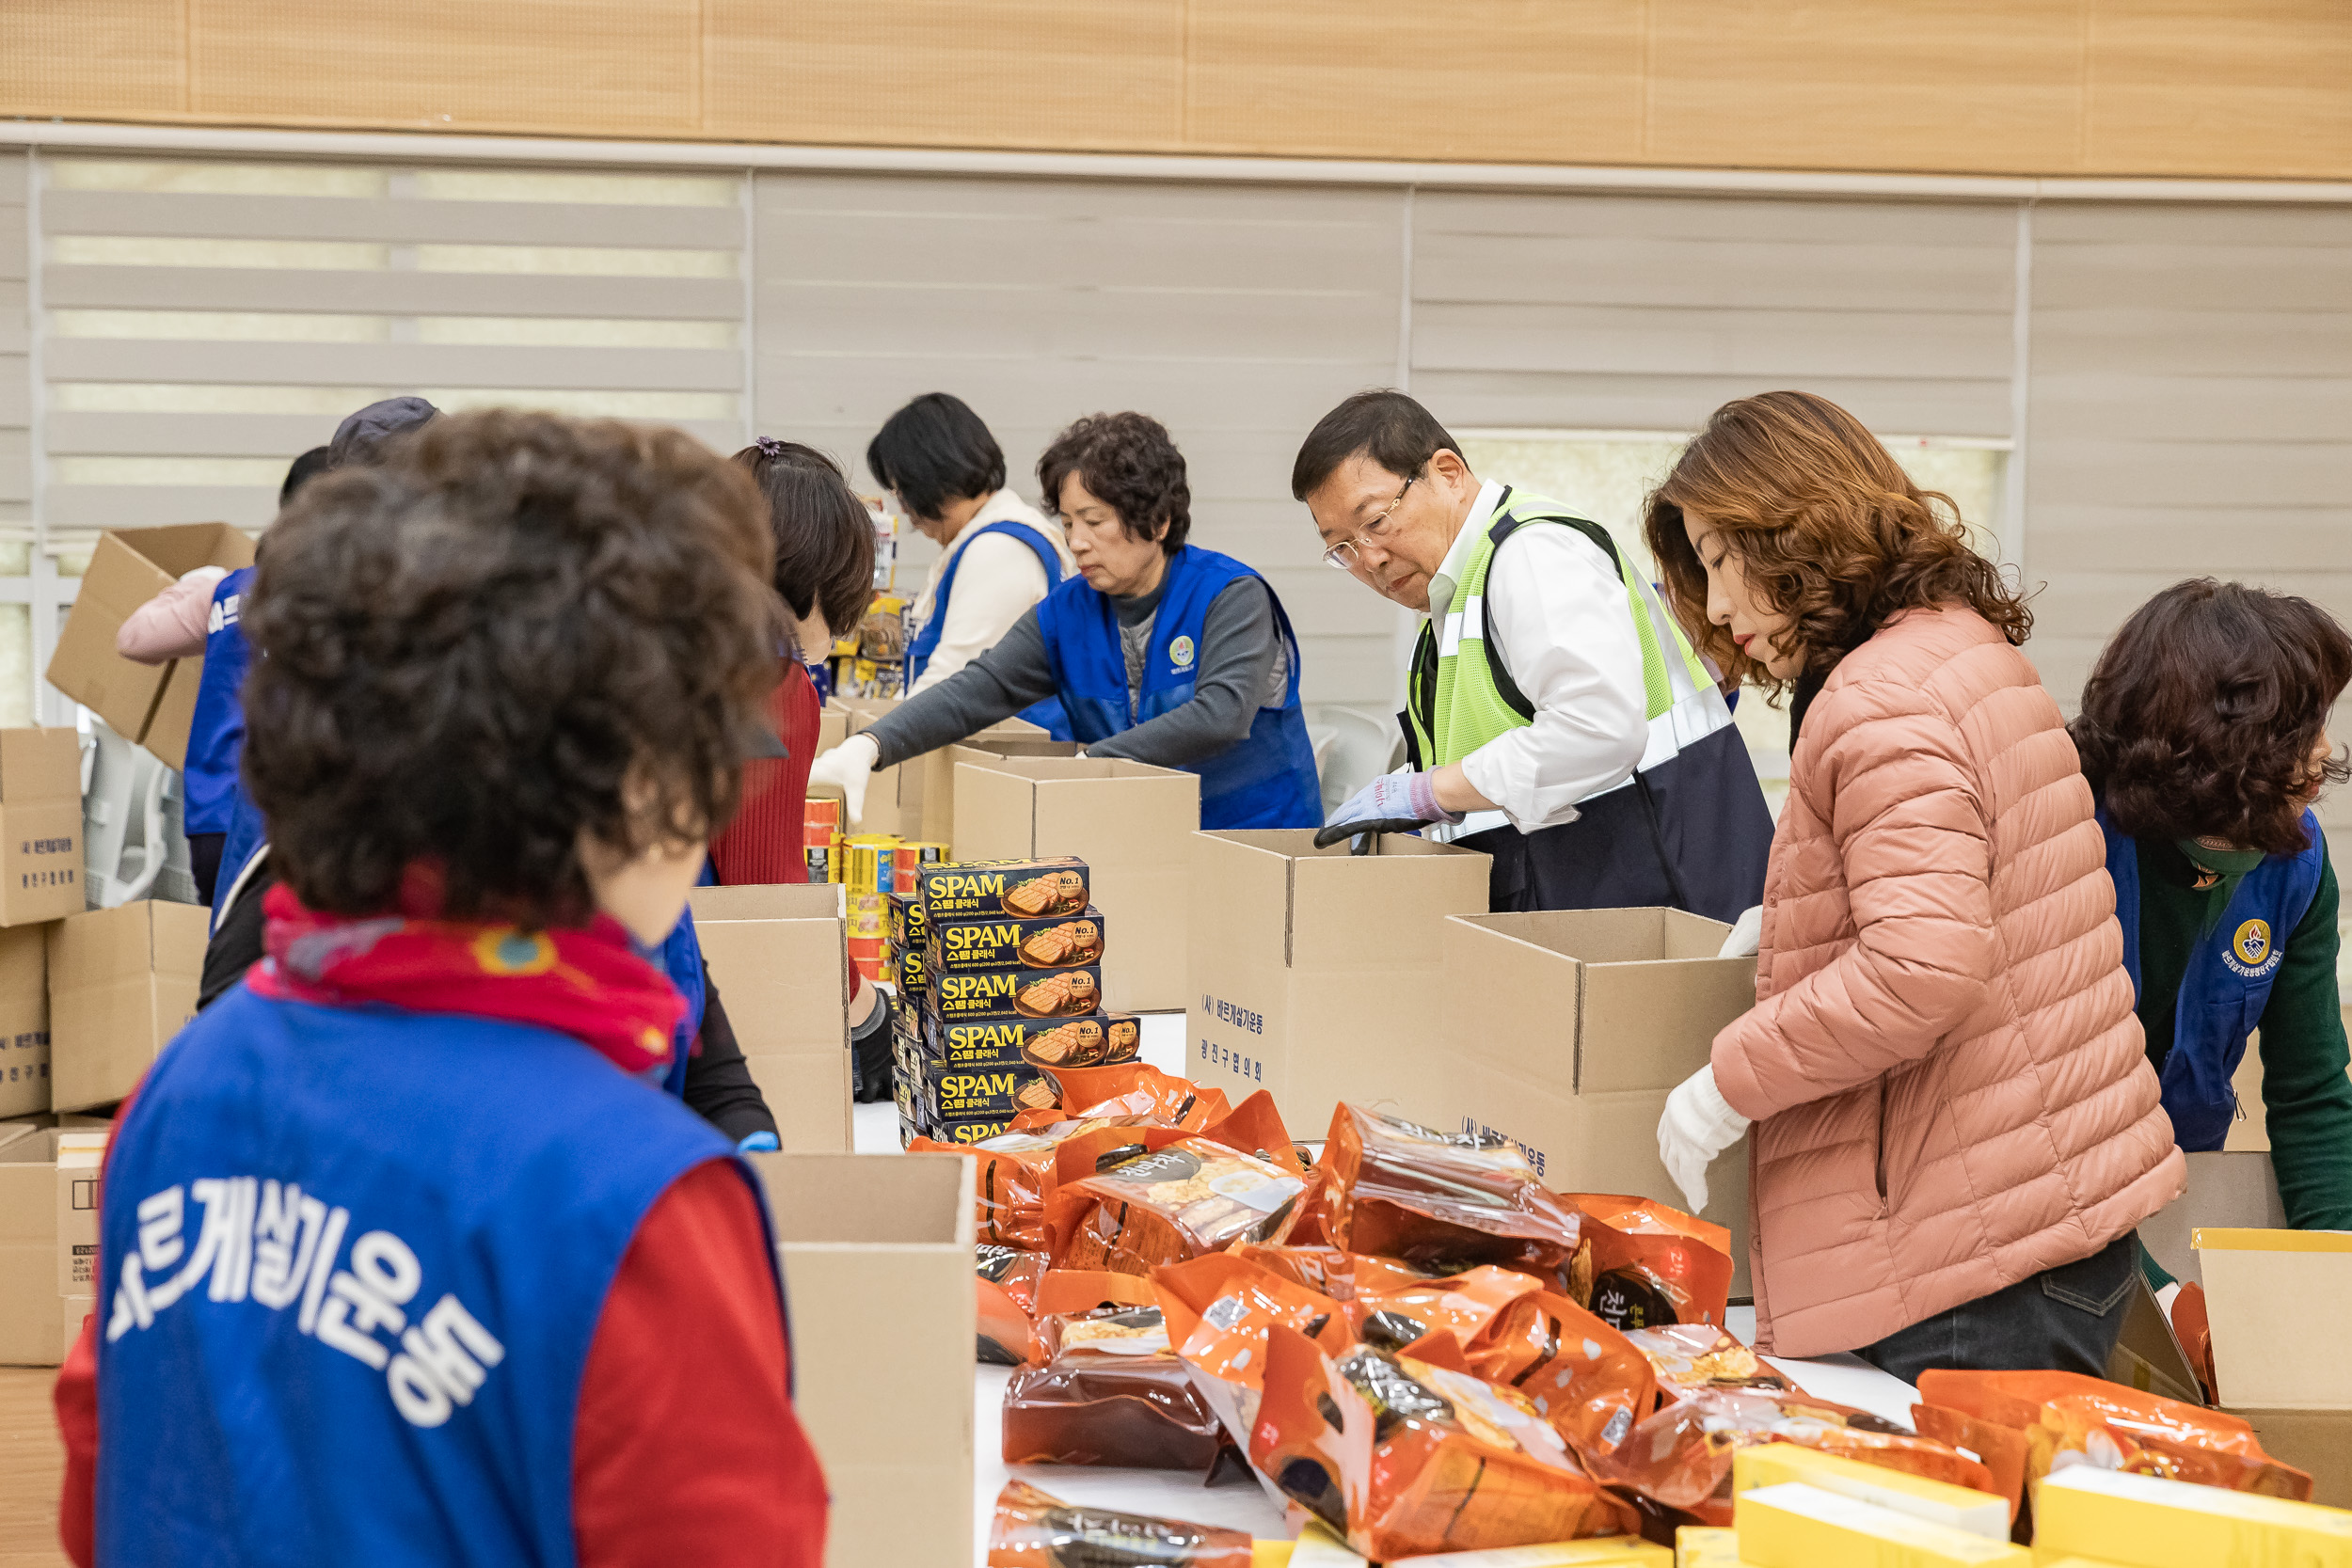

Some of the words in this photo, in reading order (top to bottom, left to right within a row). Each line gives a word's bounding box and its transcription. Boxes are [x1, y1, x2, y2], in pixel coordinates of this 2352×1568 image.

[929, 874, 1004, 899] SPAM
[1059, 877, 1079, 885] No.1
[930, 899, 954, 911] 스팸
[956, 898, 979, 909] 클래식
[946, 925, 1020, 950] SPAM
[946, 950, 970, 961] 스팸
[972, 949, 995, 959] 클래식
[941, 974, 1017, 1000] SPAM
[1071, 976, 1091, 985] No.1
[943, 999, 966, 1011] 스팸
[967, 998, 991, 1009] 클래식
[1201, 993, 1215, 1015] (사)
[1216, 999, 1263, 1035] 바르게살기운동
[949, 1023, 1025, 1050] SPAM
[1079, 1026, 1099, 1035] No.1
[950, 1049, 974, 1061] 스팸
[975, 1048, 999, 1059] 클래식
[941, 1073, 1015, 1099] SPAM
[942, 1099, 965, 1110] 스팸
[966, 1098, 990, 1108] 클래식
[955, 1122, 1010, 1145] SPA
